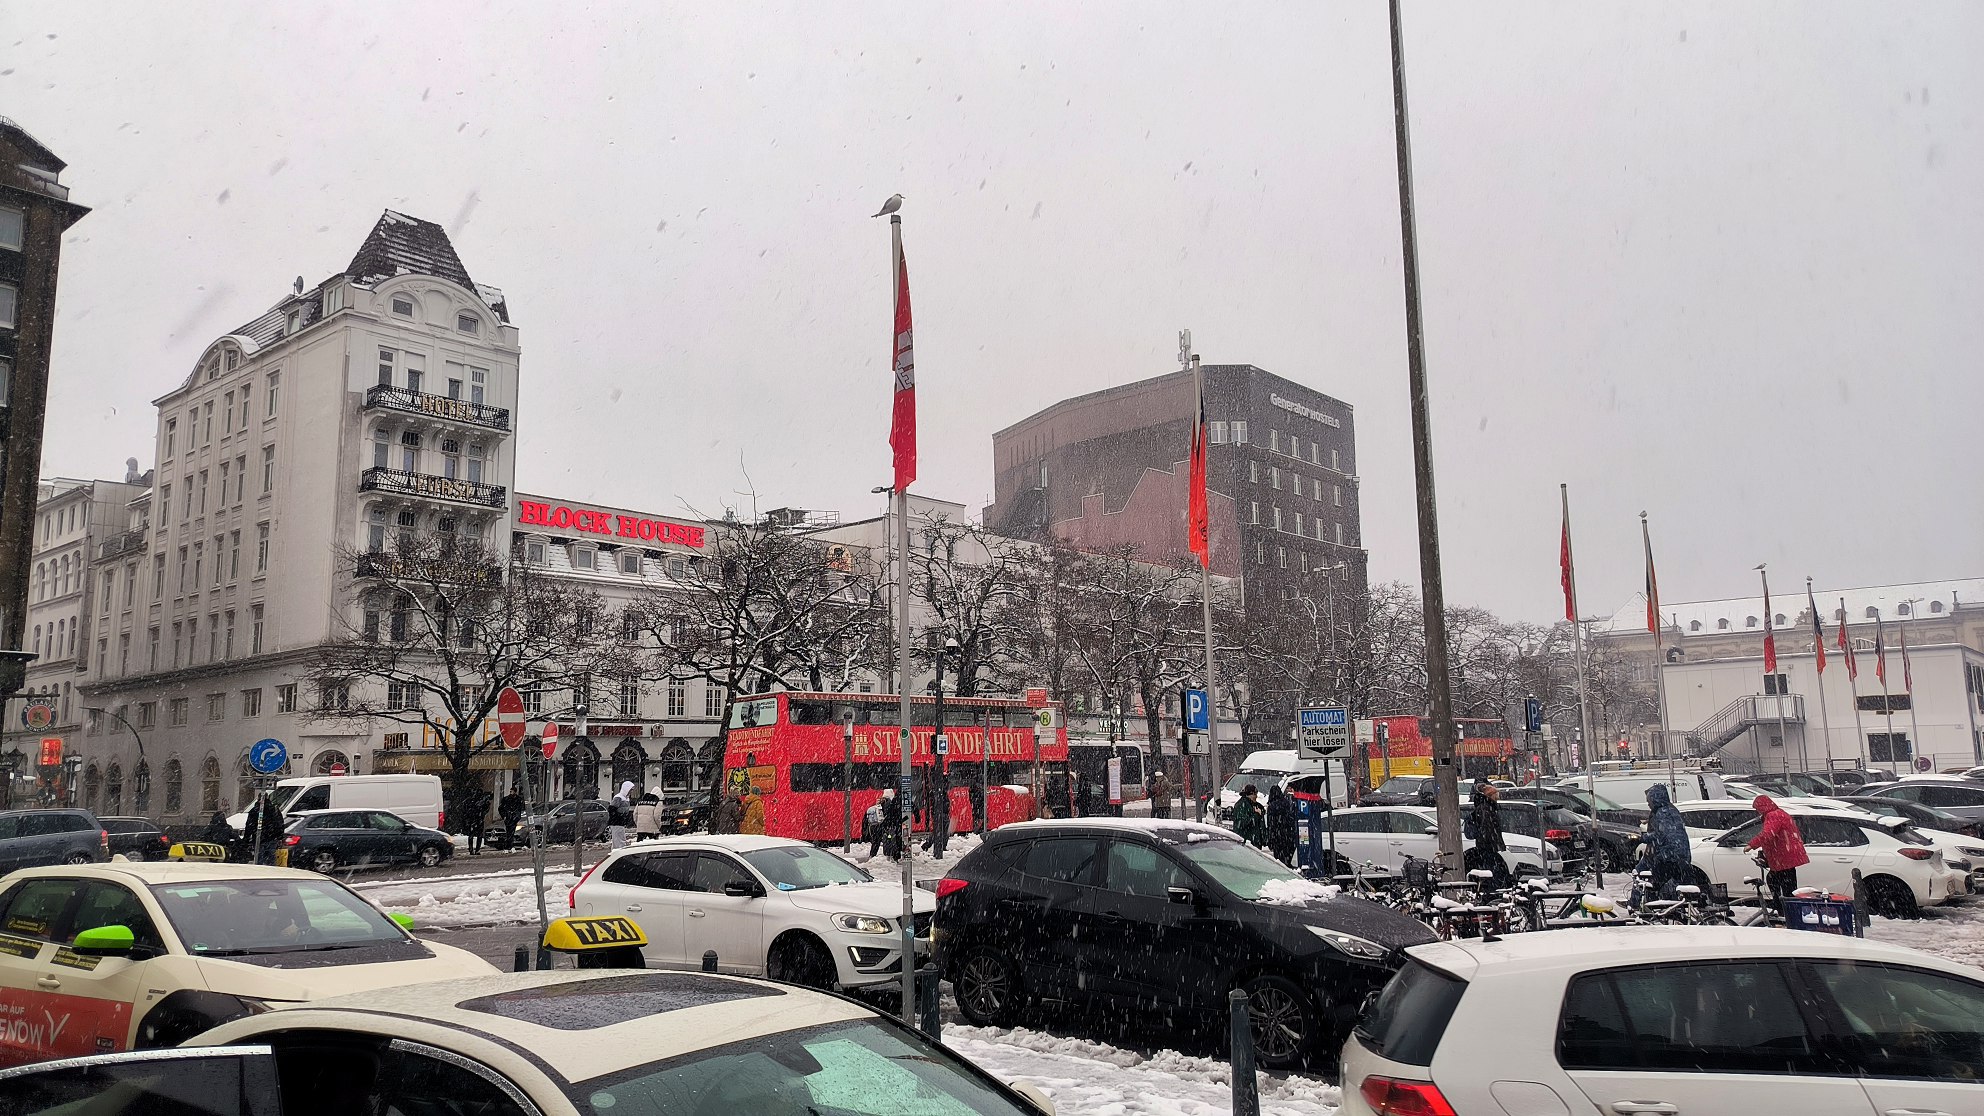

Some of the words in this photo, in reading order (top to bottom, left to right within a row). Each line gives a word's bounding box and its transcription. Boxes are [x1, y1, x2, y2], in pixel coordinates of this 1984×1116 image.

[422, 396, 474, 420] HOTEL
[1270, 393, 1309, 418] Generator
[1310, 409, 1340, 429] HOSTELS
[519, 501, 612, 535] BLOCK
[616, 515, 705, 548] HOUSE
[1190, 694, 1202, 724] P
[1303, 711, 1344, 724] AUTOMAT
[1302, 726, 1346, 735] Parkschein
[1304, 737, 1320, 746] hier
[1323, 736, 1346, 746] lösen
[1301, 801, 1307, 812] P
[187, 845, 220, 856] TAXI
[572, 920, 637, 943] TAXI
[10, 1006, 25, 1015] AUF
